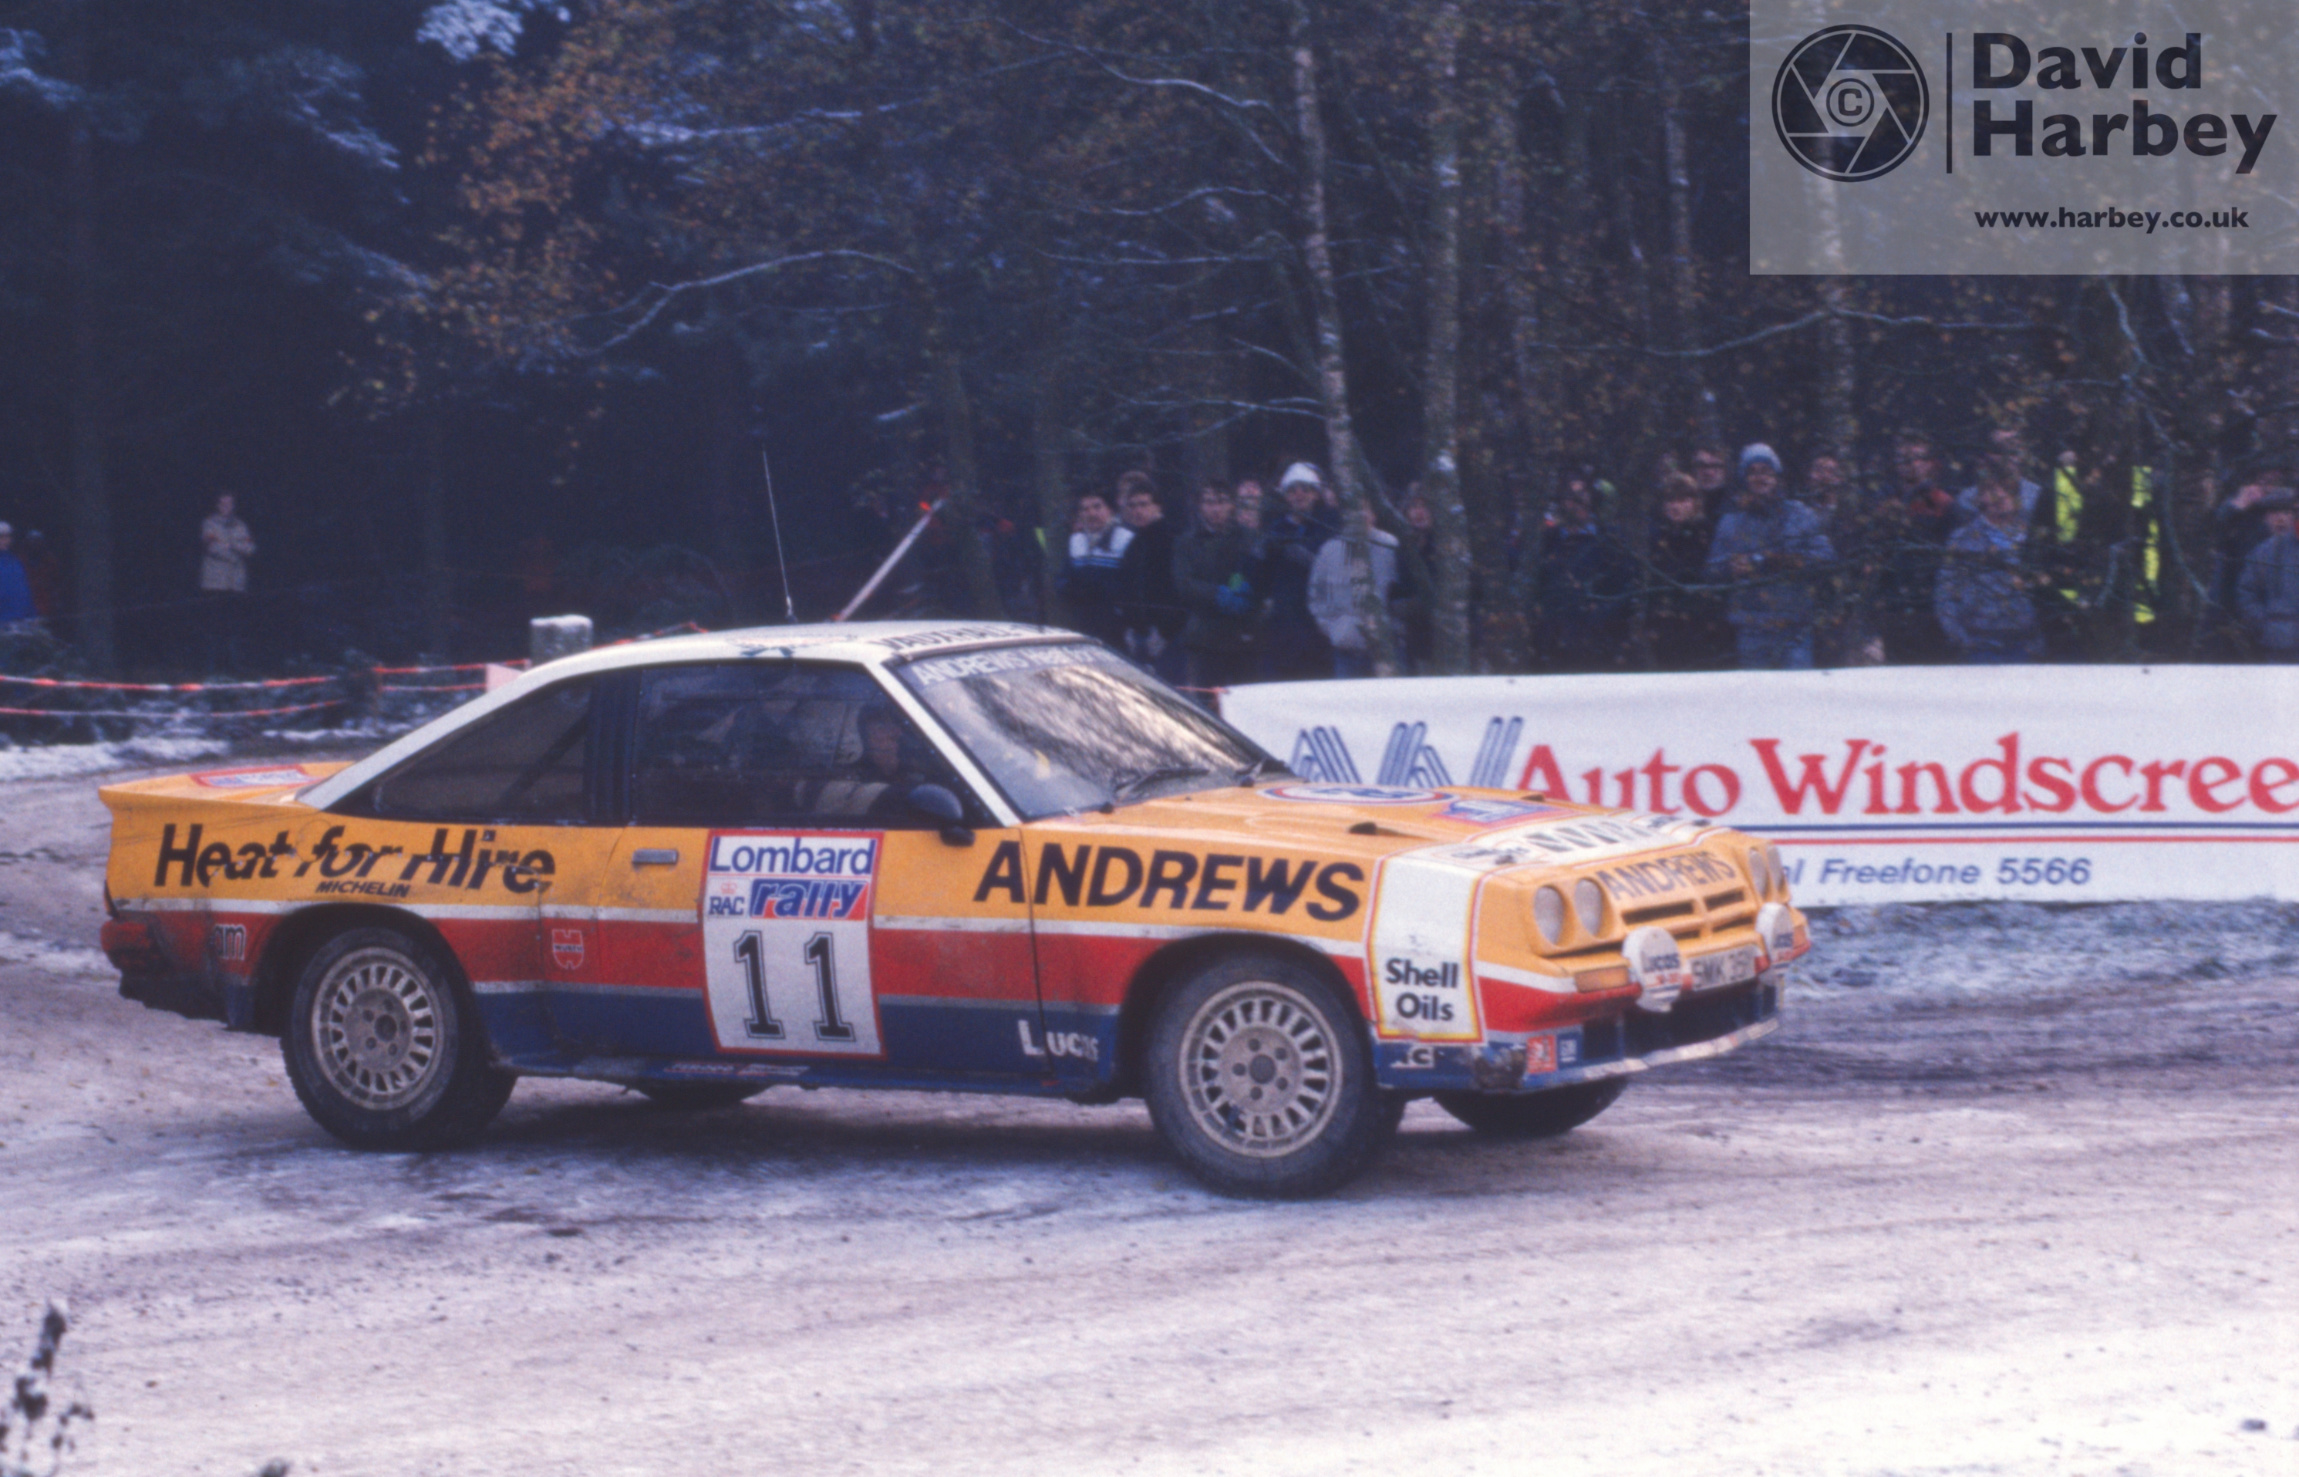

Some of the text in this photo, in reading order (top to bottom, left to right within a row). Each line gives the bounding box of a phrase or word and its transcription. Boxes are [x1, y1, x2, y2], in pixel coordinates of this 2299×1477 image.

[1516, 731, 2299, 817] Auto Windscree
[153, 822, 556, 895] Heat for Hire
[708, 836, 878, 876] Lombard
[1599, 849, 1738, 900] ANDREWS
[1818, 858, 1982, 885] Freefone
[1996, 857, 2092, 886] 5566
[314, 879, 412, 899] MICHELIN
[708, 878, 869, 920] RAC rally
[972, 839, 1365, 922] ANDREWS
[733, 929, 856, 1042] 11
[1385, 957, 1459, 989] Shell
[1395, 993, 1454, 1022] Oils
